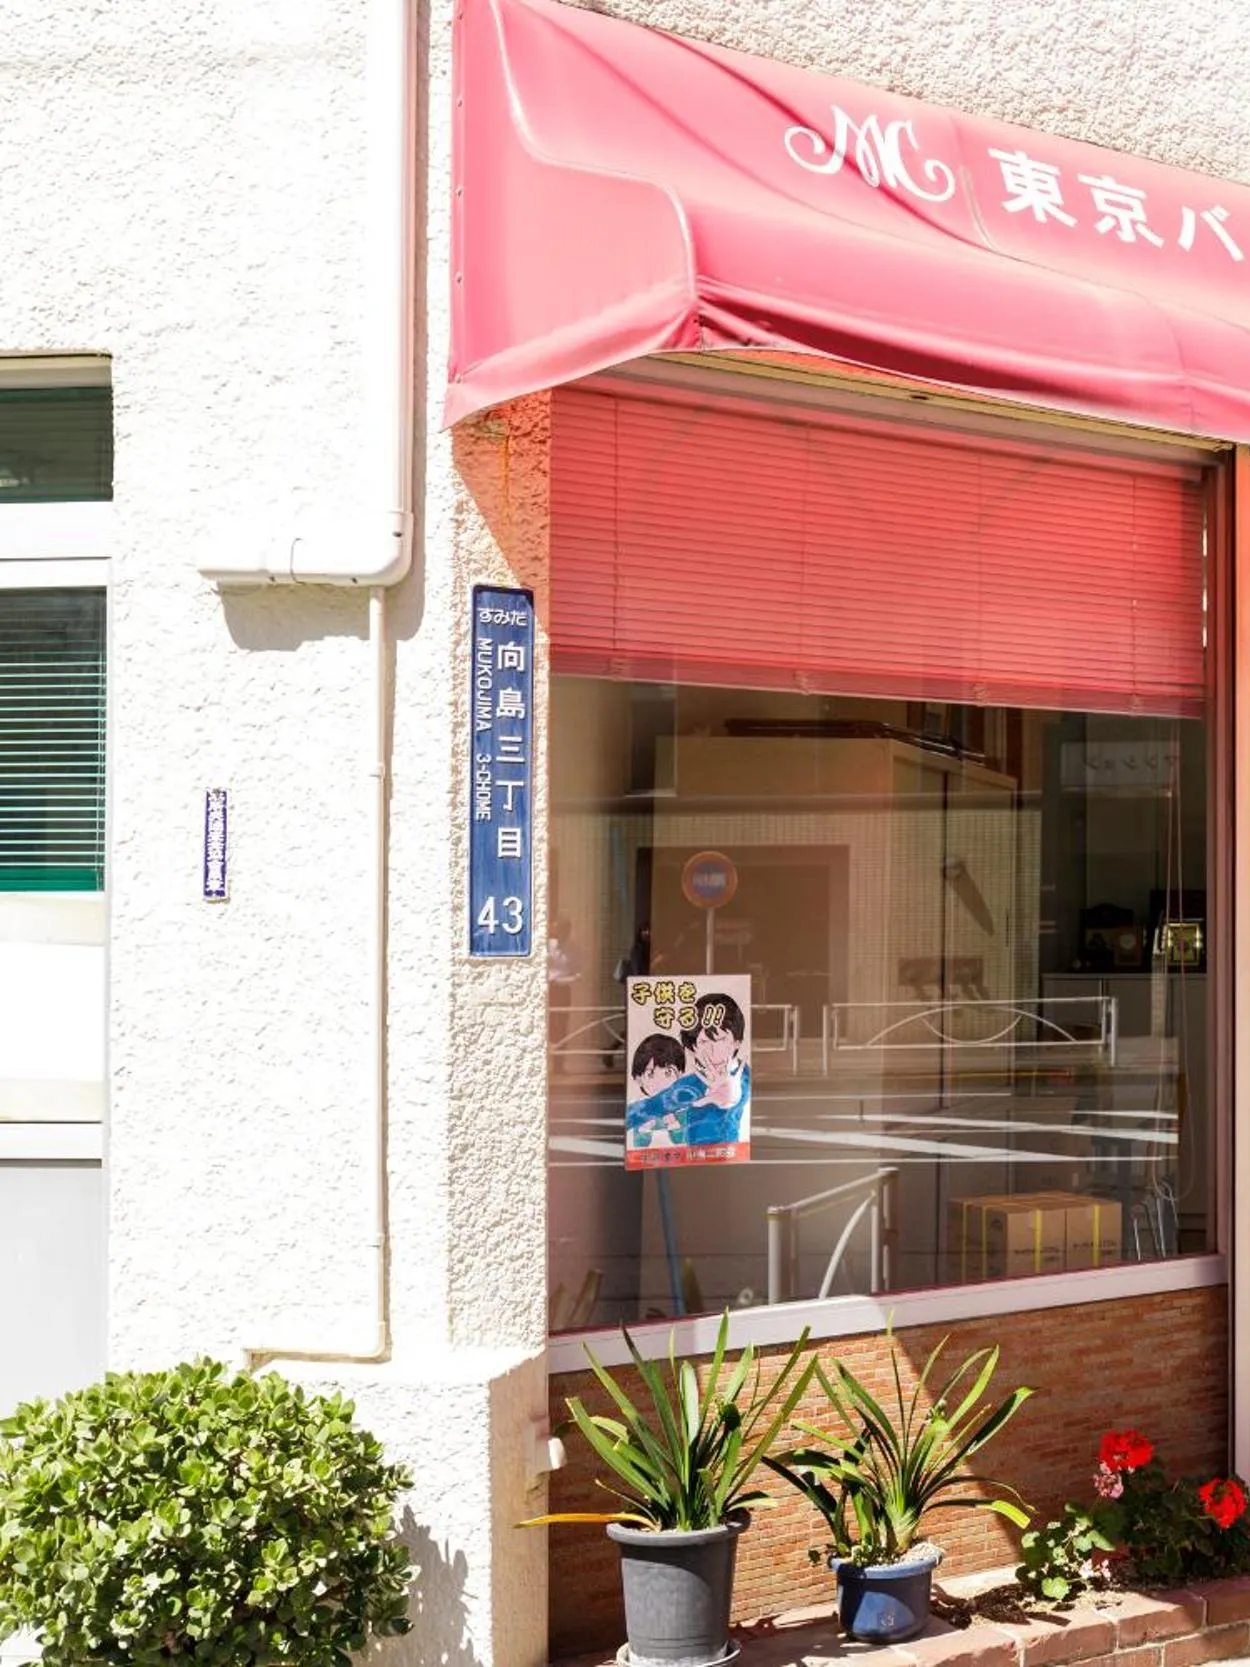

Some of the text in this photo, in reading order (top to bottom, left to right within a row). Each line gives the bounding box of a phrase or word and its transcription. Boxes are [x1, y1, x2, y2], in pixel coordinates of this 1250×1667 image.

[476, 606, 528, 627] すみだ
[475, 637, 494, 822] MUKOJIMA 3-CHOME
[495, 641, 526, 859] 向島三丁目
[476, 895, 524, 936] 43
[631, 981, 697, 1006] 子供を
